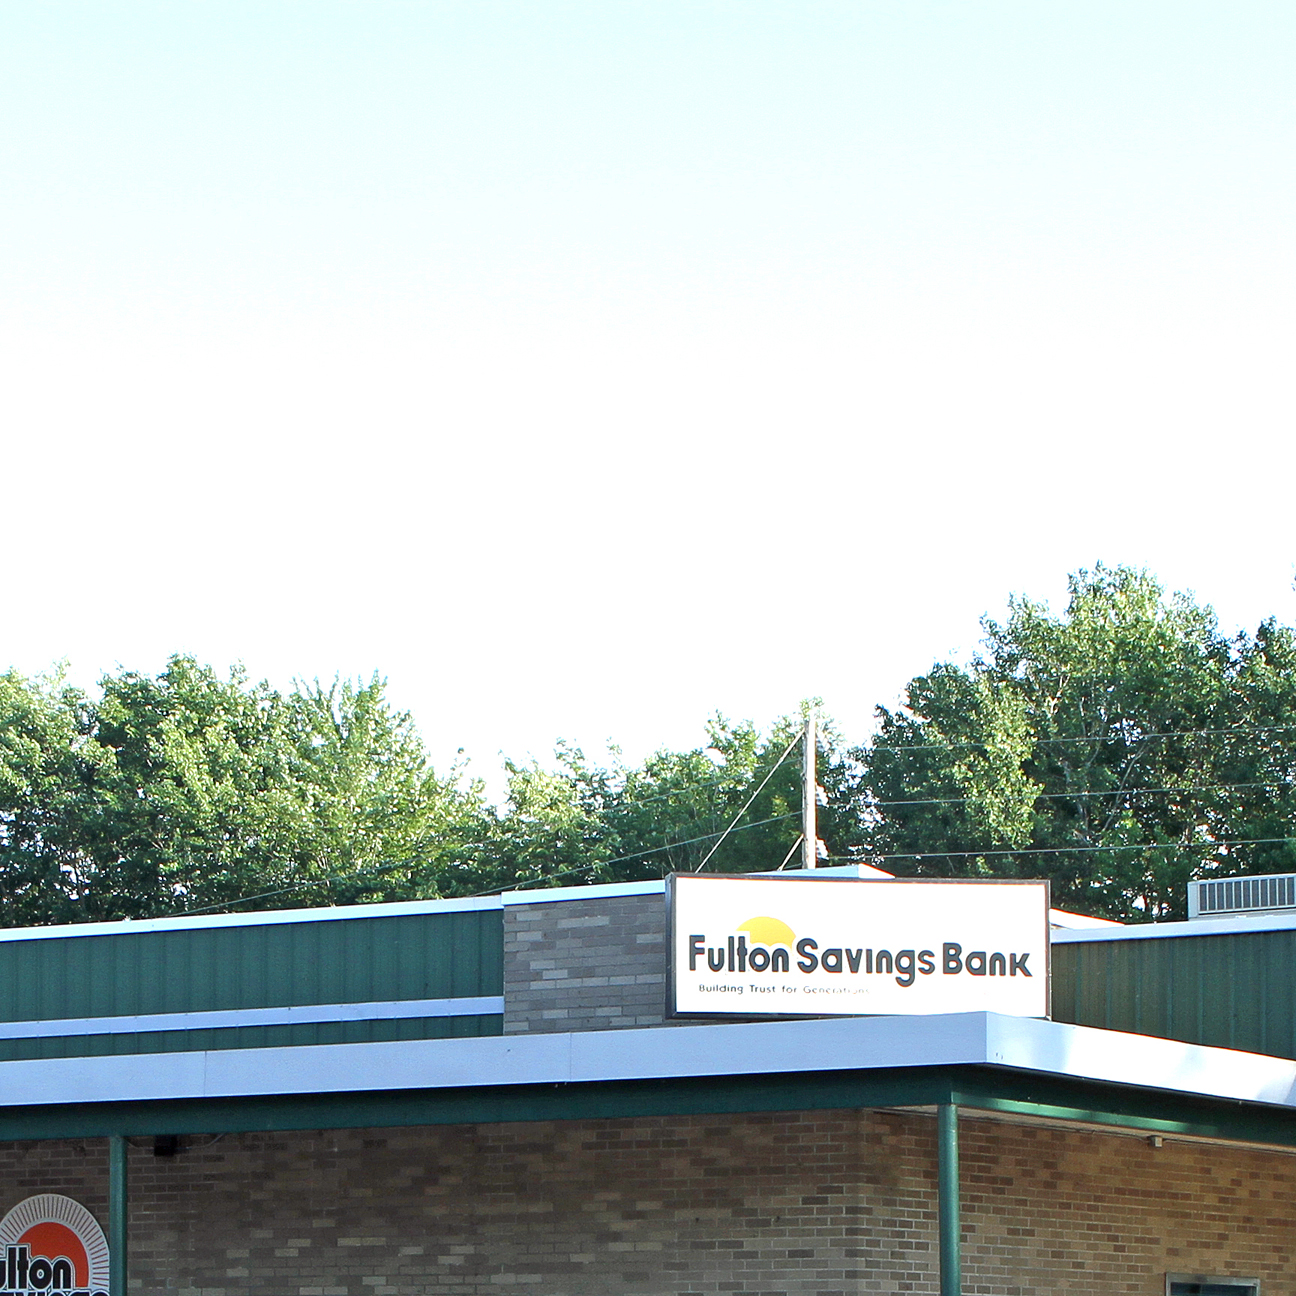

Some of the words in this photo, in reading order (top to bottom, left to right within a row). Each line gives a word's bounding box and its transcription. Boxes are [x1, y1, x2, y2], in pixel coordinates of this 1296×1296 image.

[688, 934, 790, 973] Fulton
[796, 937, 936, 987] Savings
[942, 942, 1033, 977] Bank
[698, 984, 744, 995] Building
[749, 984, 776, 993] Trust
[782, 985, 798, 993] for
